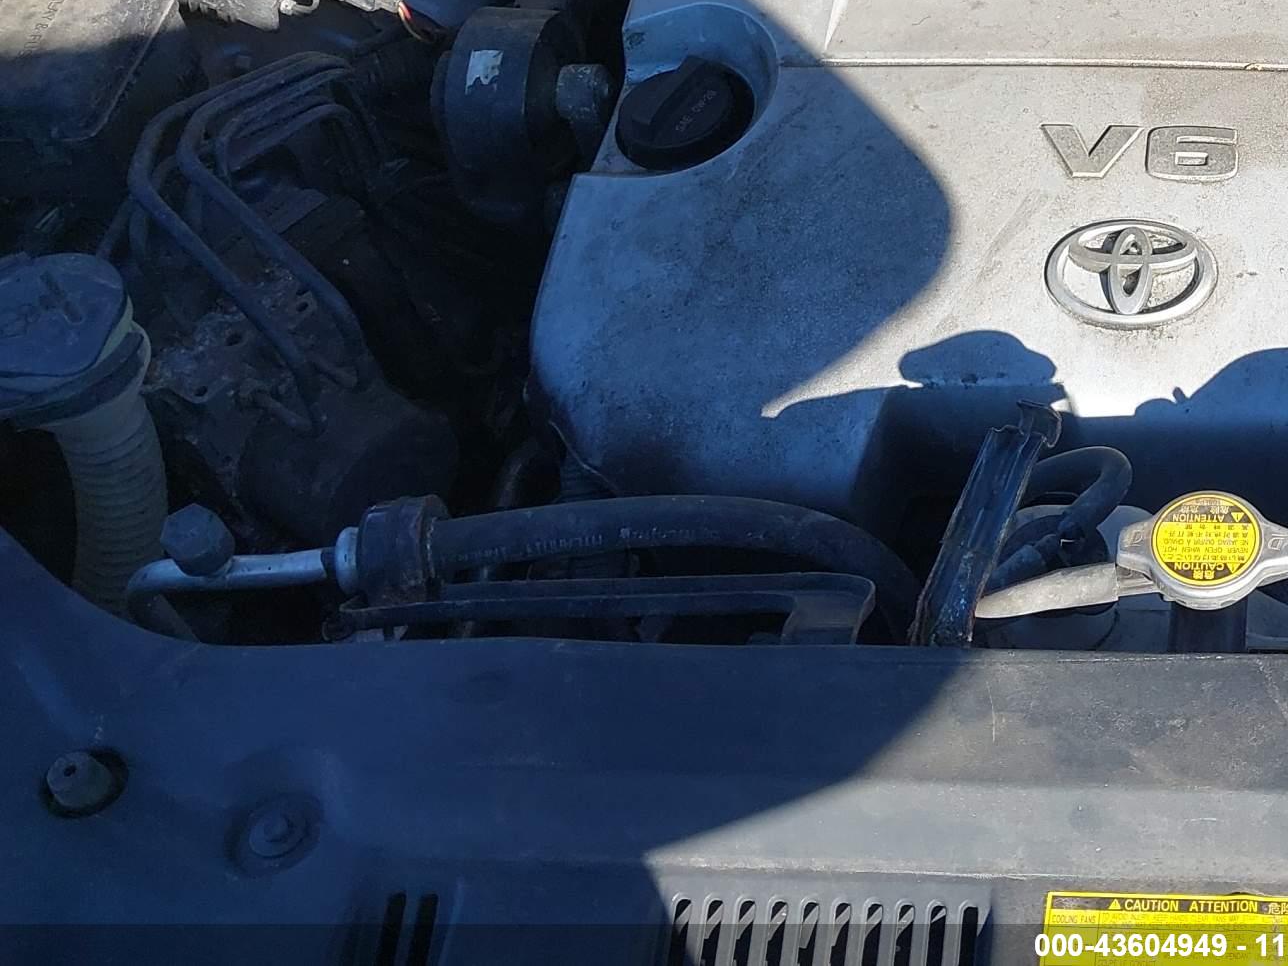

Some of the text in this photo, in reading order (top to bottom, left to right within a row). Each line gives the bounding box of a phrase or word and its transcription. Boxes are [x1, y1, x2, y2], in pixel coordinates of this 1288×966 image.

[1039, 123, 1239, 184] V6
[1172, 514, 1225, 523] ATTENTION
[1174, 562, 1225, 571] CAUTION
[1124, 899, 1179, 912] CAUTION
[1188, 900, 1258, 914] ATTENTION
[1051, 914, 1078, 924] COOLING
[1080, 915, 1096, 924] FANS
